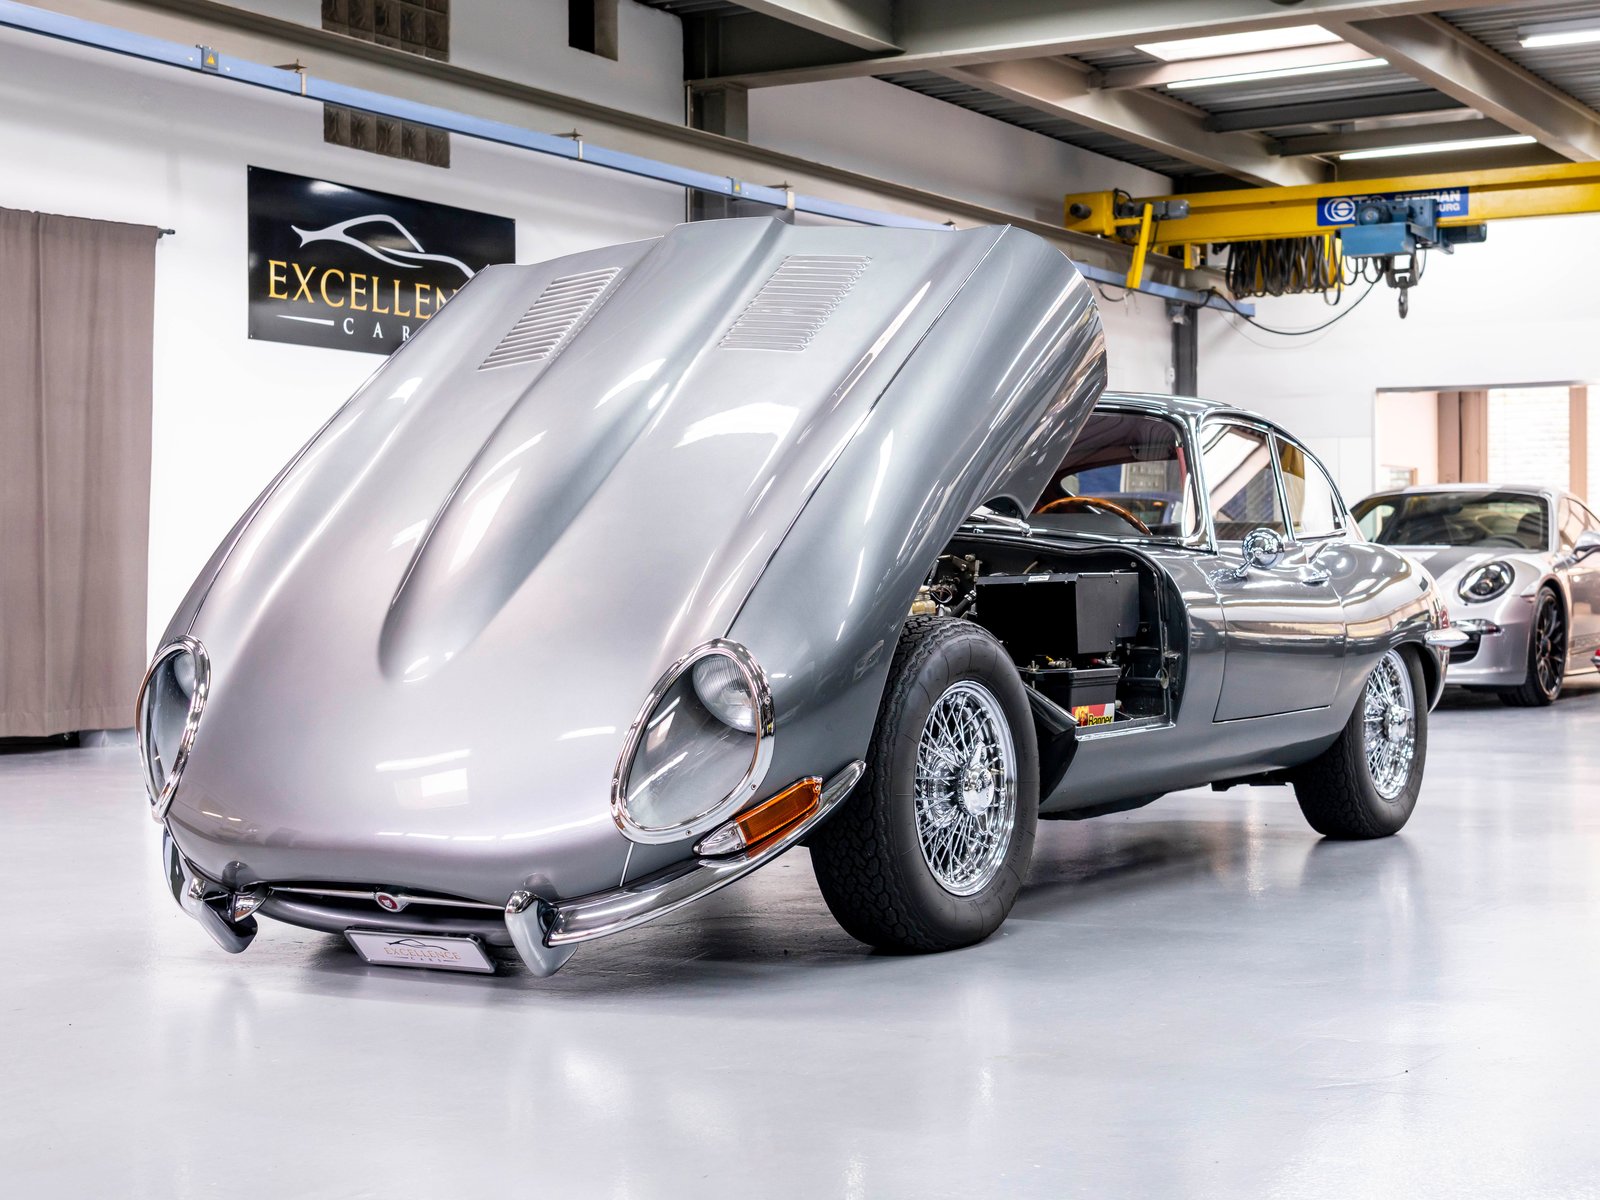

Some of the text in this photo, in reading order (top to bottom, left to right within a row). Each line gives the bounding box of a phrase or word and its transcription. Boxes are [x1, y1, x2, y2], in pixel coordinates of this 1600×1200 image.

[268, 259, 458, 320] EXCELLEN
[343, 318, 410, 342] CAR
[1088, 714, 1113, 726] Banner
[383, 947, 462, 960] EXCELLENCE
